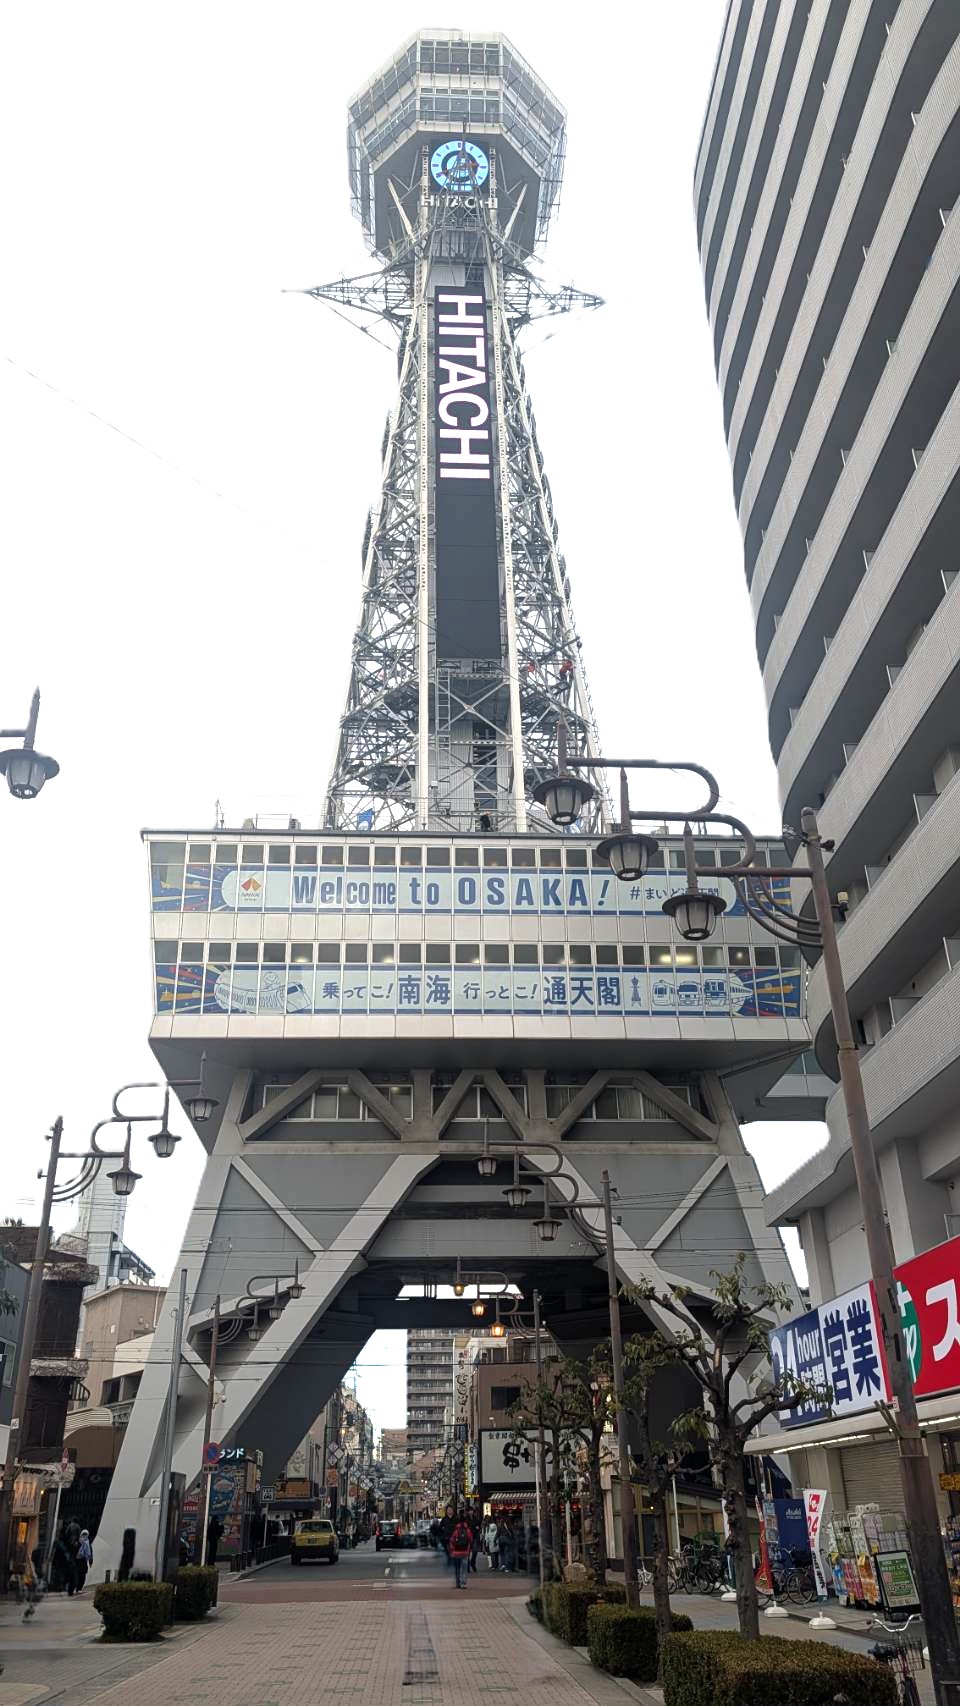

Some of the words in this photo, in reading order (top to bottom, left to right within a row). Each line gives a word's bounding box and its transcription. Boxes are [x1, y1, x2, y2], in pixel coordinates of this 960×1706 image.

[438, 294, 491, 480] HITACHI
[293, 875, 397, 905] Welcome
[409, 876, 440, 905] to
[770, 1329, 803, 1420] 24
[795, 1327, 821, 1364] hour
[823, 1299, 881, 1405] 営業
